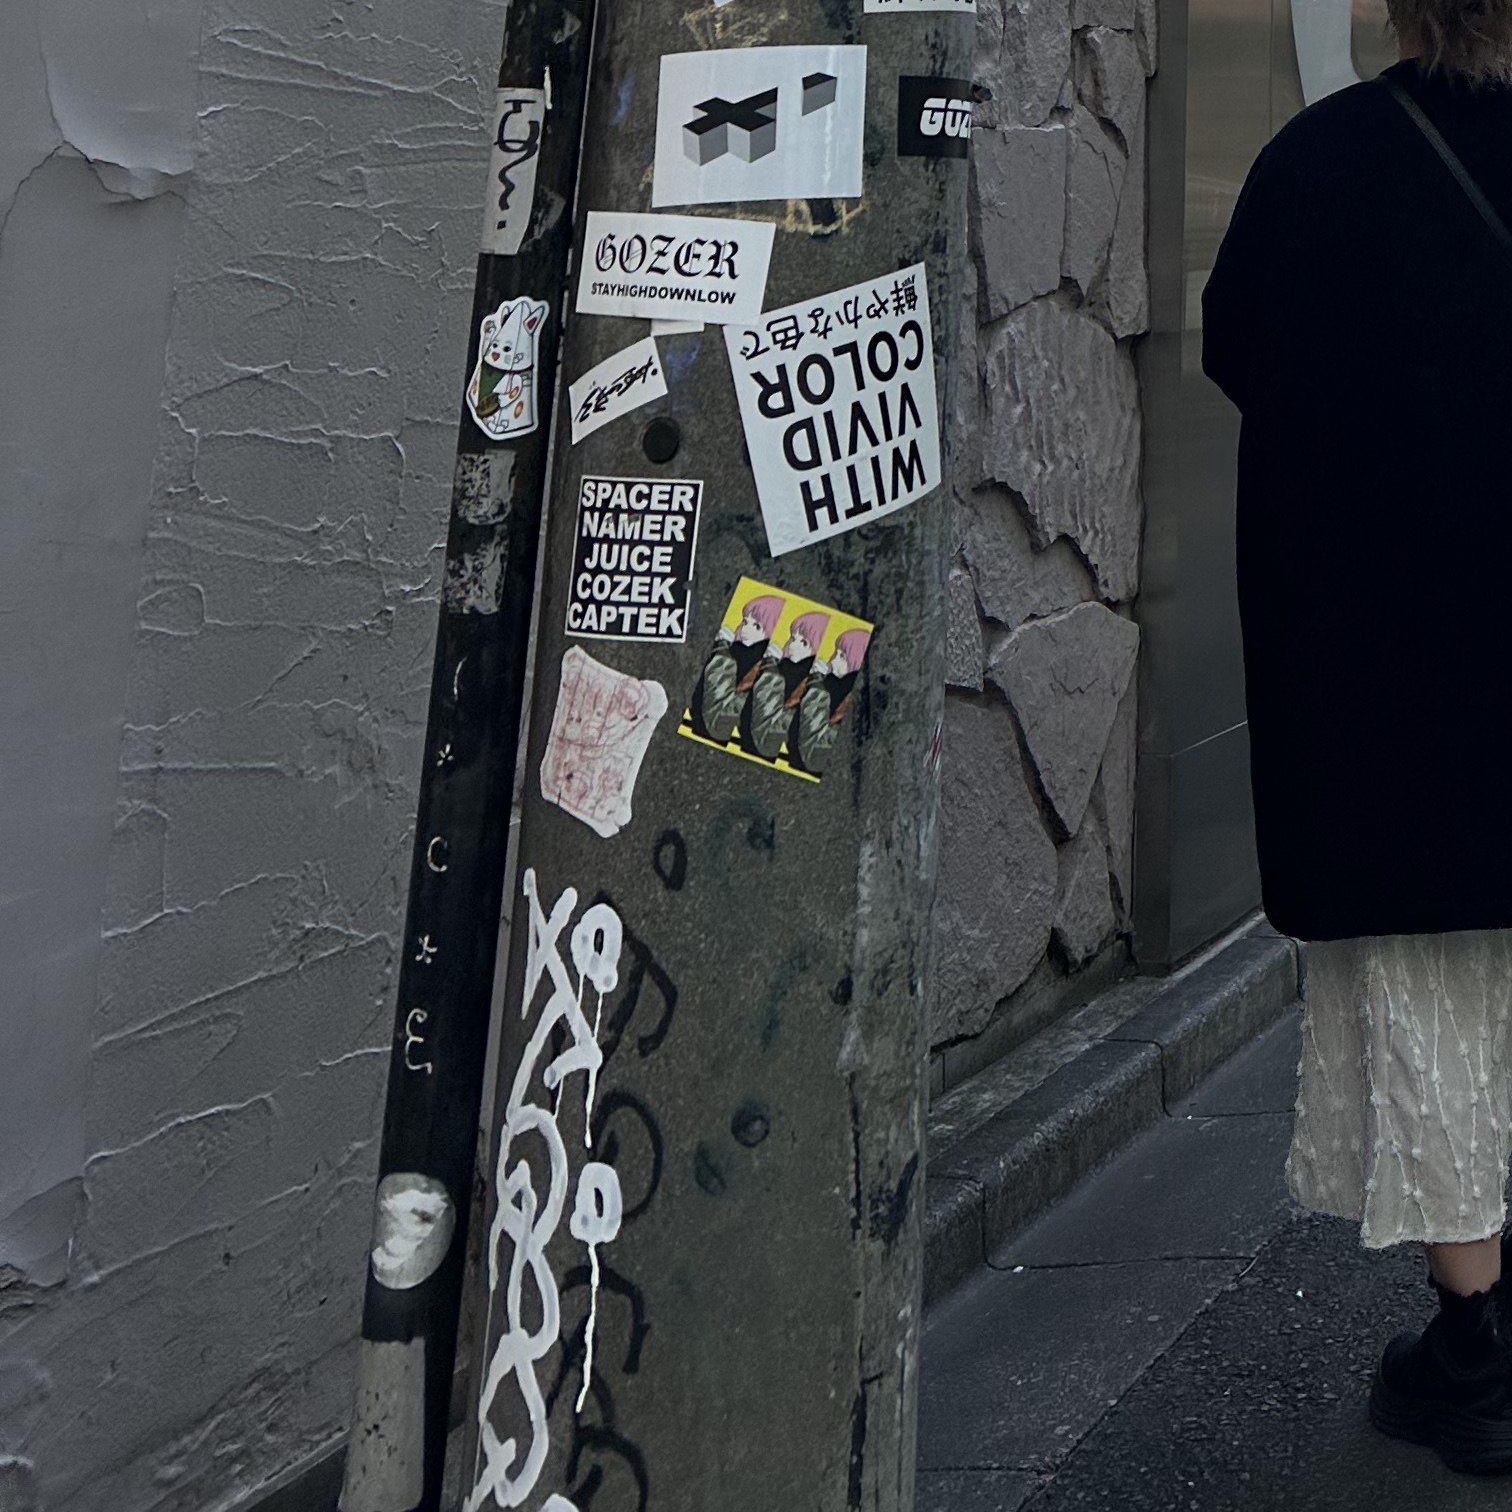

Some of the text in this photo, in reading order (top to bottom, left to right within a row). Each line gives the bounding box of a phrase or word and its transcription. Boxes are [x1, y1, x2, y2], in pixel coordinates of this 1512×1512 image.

[595, 233, 740, 280] GOZER
[591, 282, 737, 305] STAYHIGHDOWNLOW
[739, 274, 918, 360] 鮮やかな色で
[750, 319, 924, 419] COLOR
[782, 382, 922, 471] VIVID
[581, 480, 694, 512] SPACER
[800, 438, 927, 533] WITH
[582, 510, 687, 542] NAMER
[584, 542, 674, 574] JUICE
[576, 572, 677, 605] COZEK
[568, 601, 685, 636] CAPTEK
